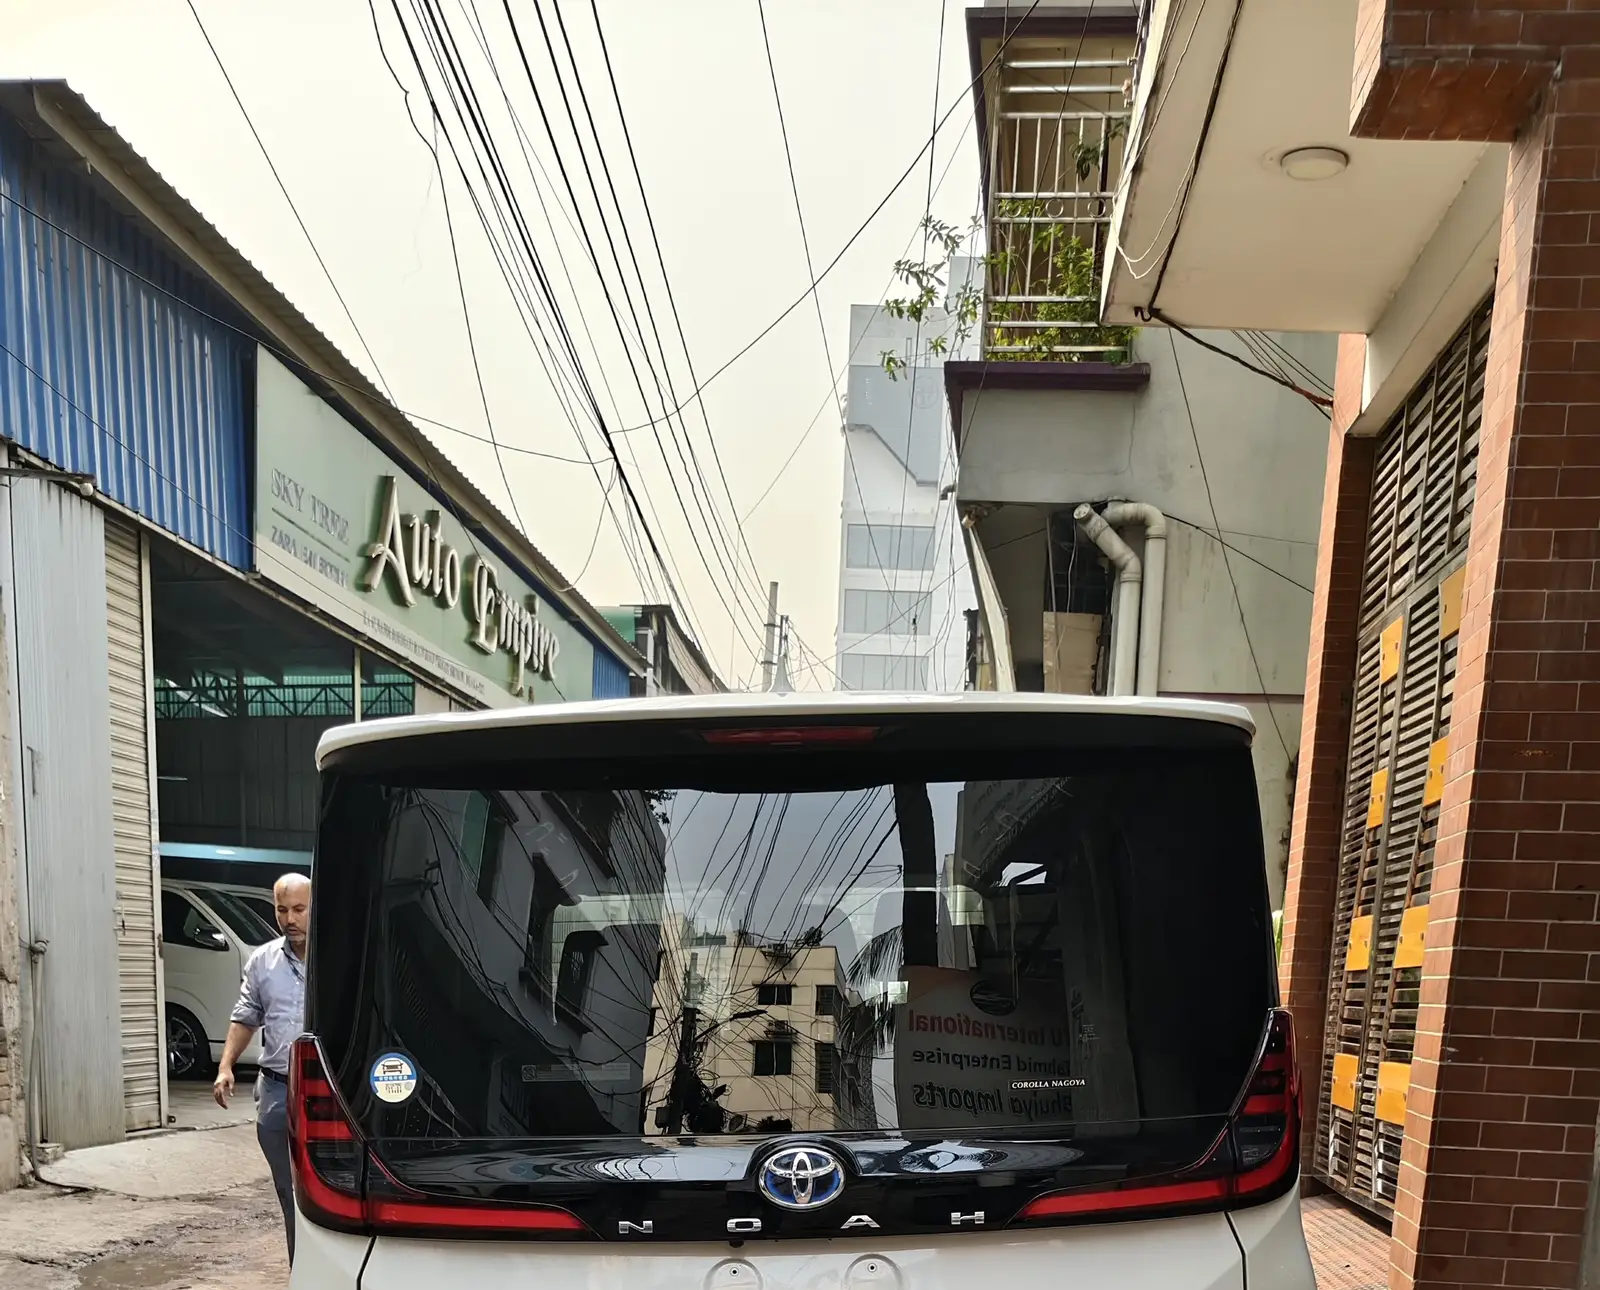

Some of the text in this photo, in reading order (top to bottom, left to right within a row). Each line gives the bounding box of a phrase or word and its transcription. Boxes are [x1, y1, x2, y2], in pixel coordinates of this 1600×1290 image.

[271, 467, 305, 512] SKY
[362, 474, 461, 609] Auto
[470, 554, 561, 697] Empire
[1011, 1078, 1086, 1090] COROLLA NAGOYA
[618, 1211, 985, 1234] NOAH
